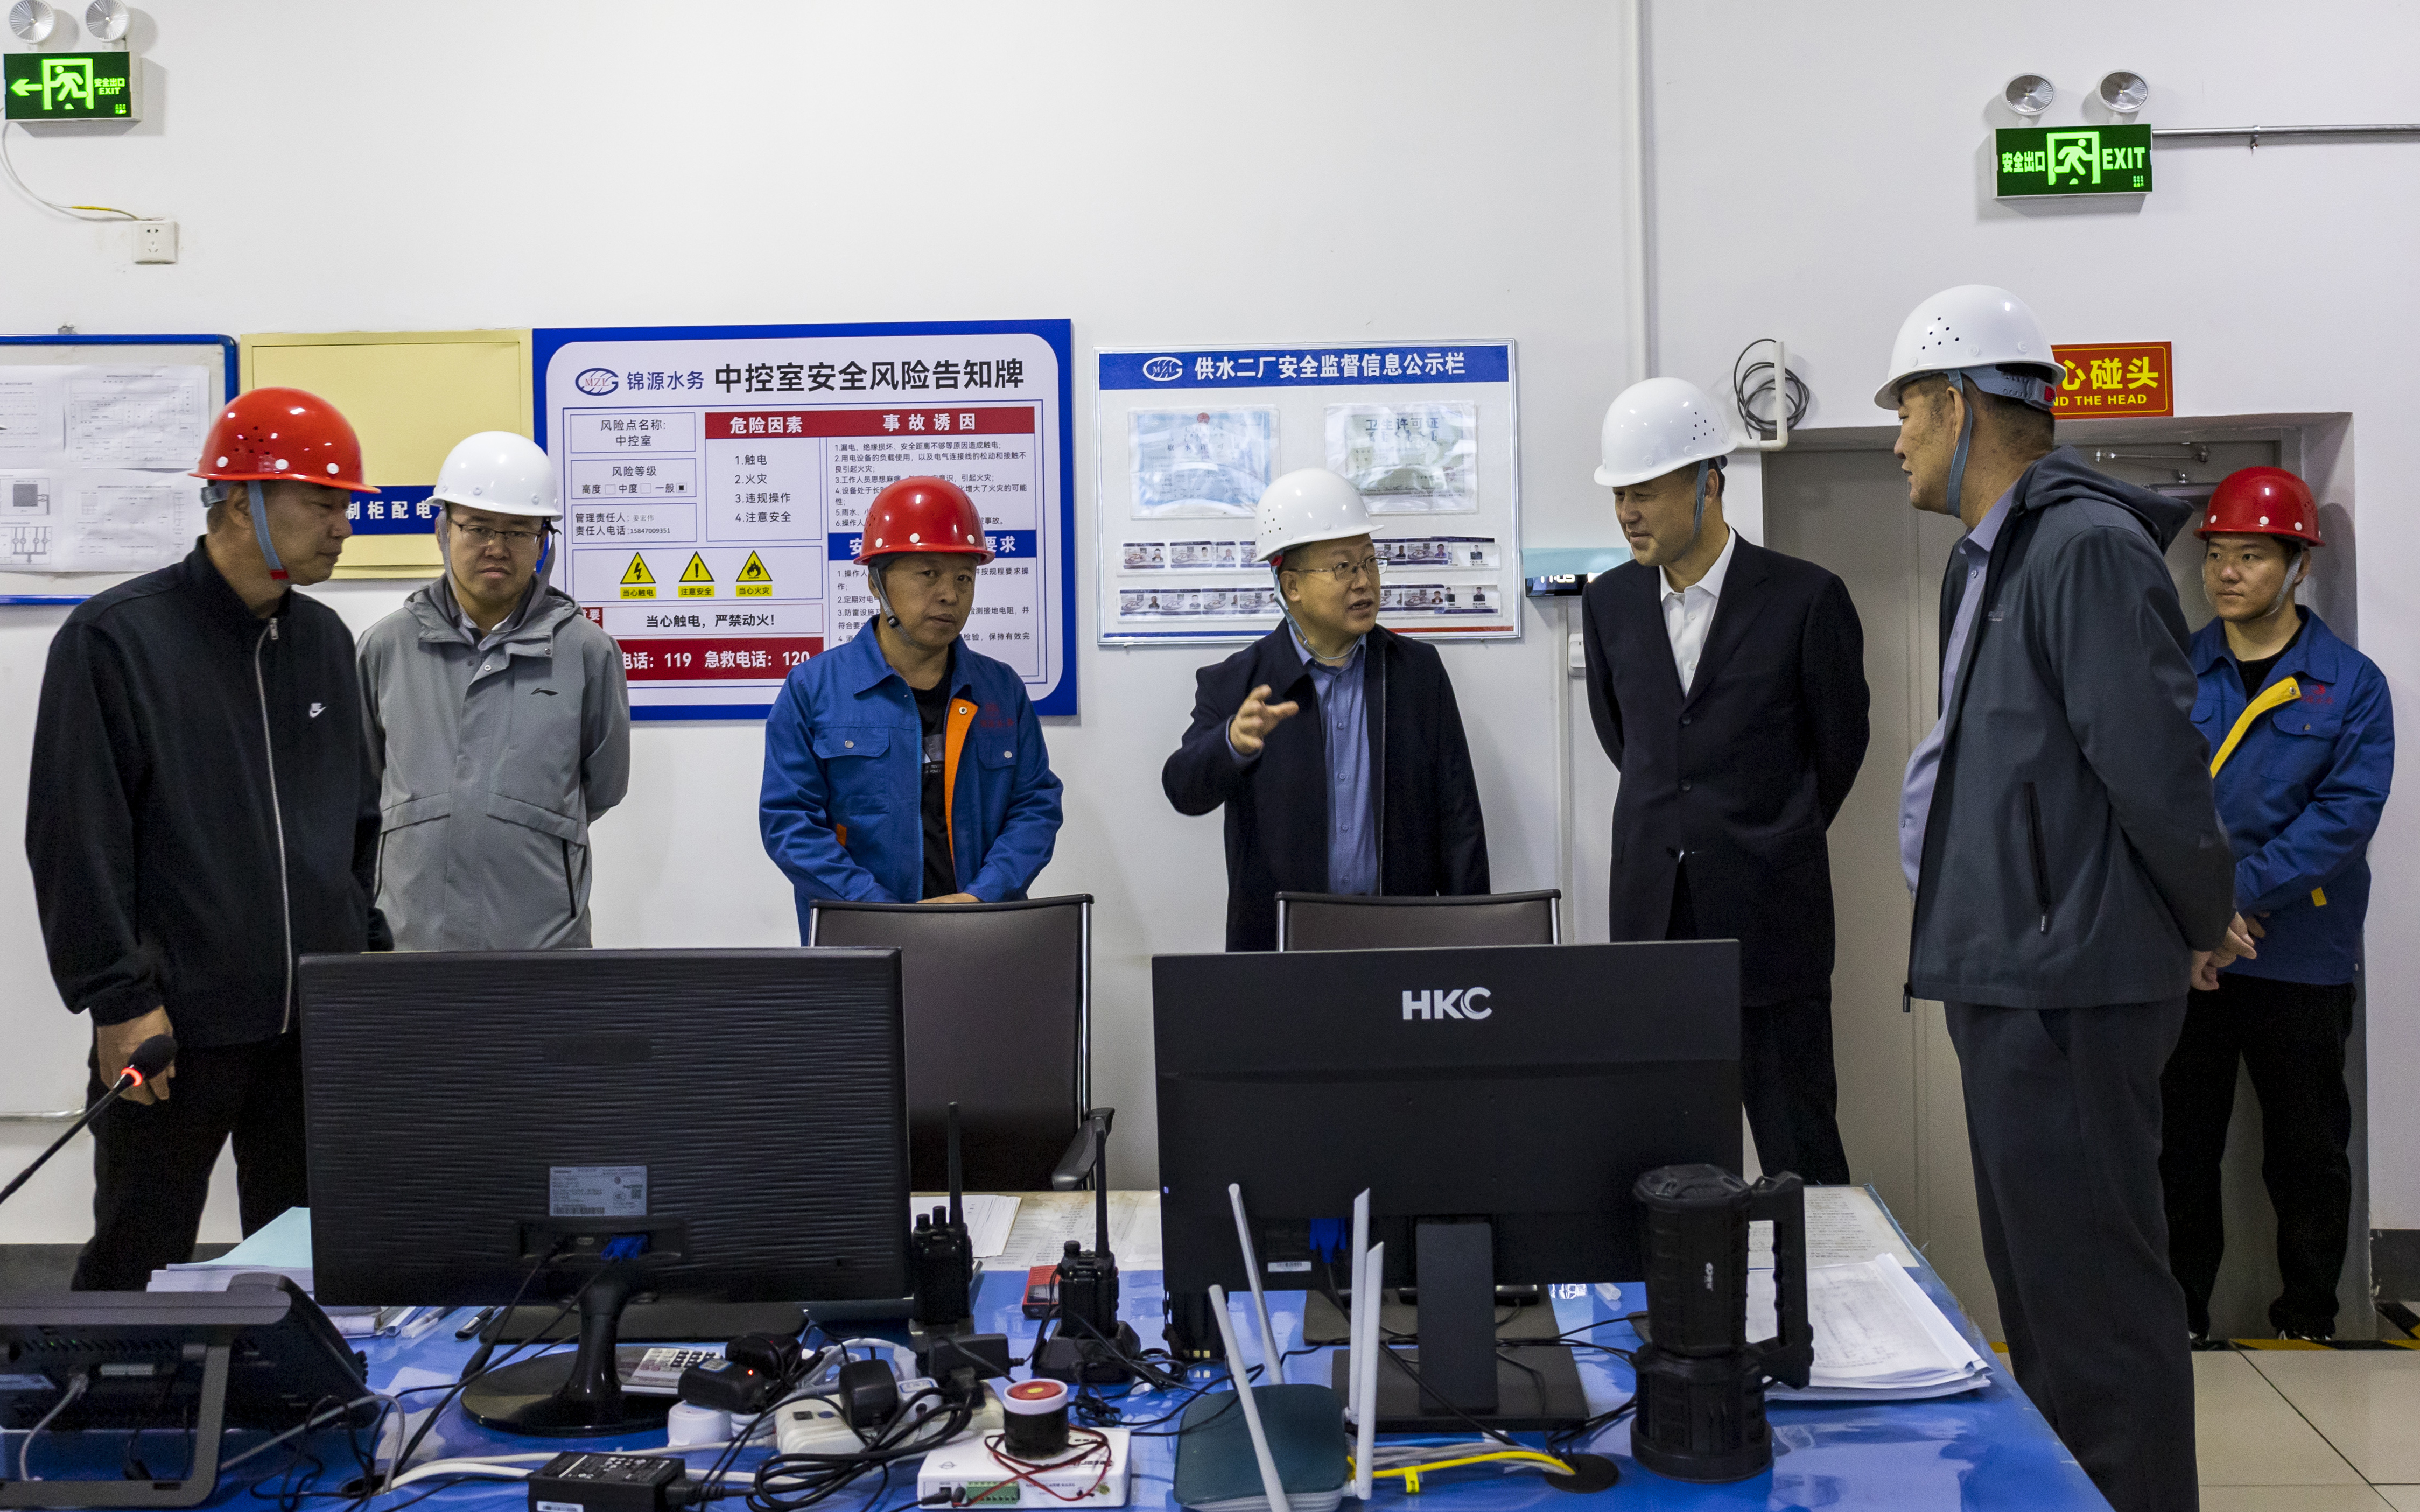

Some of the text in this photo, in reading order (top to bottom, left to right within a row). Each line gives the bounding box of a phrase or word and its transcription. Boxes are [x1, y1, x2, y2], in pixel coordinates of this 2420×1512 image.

[94, 78, 125, 87] 安全出口
[2002, 151, 2045, 173] 安全出口
[2102, 147, 2145, 170] EXIT
[1195, 352, 1465, 381] 供水二厂安全监督信息公示栏
[715, 358, 1025, 393] 中控室安全风险告知牌
[2061, 356, 2159, 390] 心碰头
[627, 371, 704, 390] 锦源水务
[2074, 395, 2102, 406] THE
[2108, 394, 2147, 405] HEAD
[729, 416, 803, 434] 危险因素
[883, 413, 976, 432] 事故诱因
[616, 435, 651, 446] 中控室
[735, 454, 767, 465] 1.触电
[612, 466, 657, 476] 风险等级
[735, 473, 767, 484] 2.火灾
[582, 483, 675, 494] 高度 中度 一般
[735, 492, 791, 503] 3.违规操作
[735, 511, 791, 523] 4.注意安全
[623, 589, 654, 597] 当心触电
[681, 587, 712, 596] 注意安全
[739, 587, 769, 595] 当心火灾
[1402, 987, 1492, 1020] HKC
